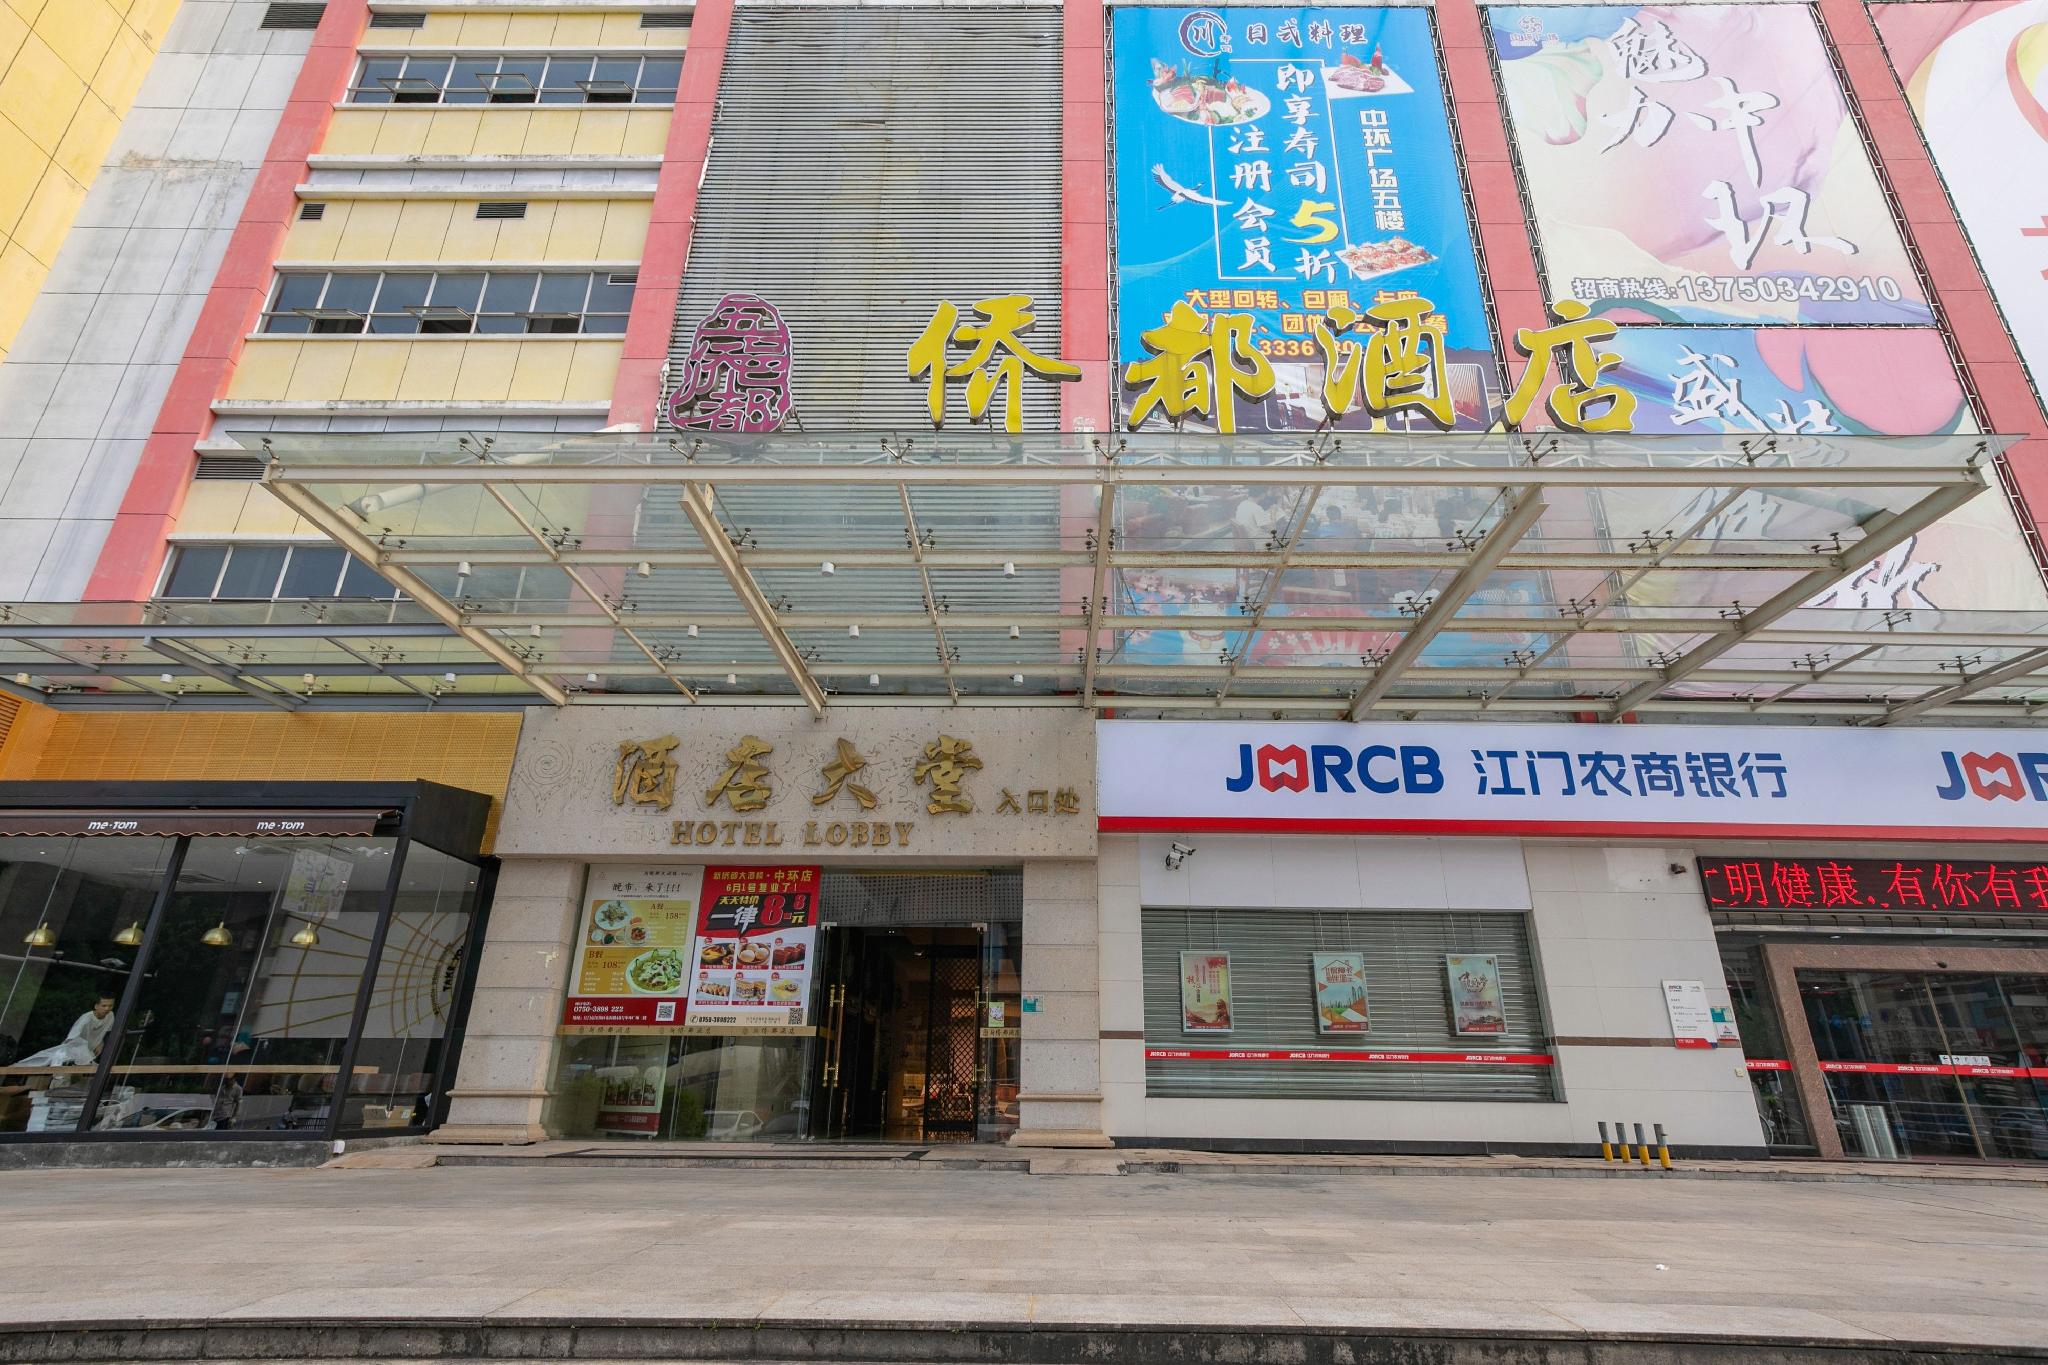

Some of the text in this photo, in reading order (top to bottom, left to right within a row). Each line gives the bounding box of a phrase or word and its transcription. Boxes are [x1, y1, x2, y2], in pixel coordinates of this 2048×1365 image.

[1247, 18, 1368, 49] 日式料理
[1359, 109, 1405, 231] 中环广场五楼
[613, 733, 985, 816] 酒店大堂
[1473, 749, 1788, 799] 江门农商银行
[996, 786, 1081, 815] 入口处
[670, 820, 915, 848] HOTEL LOBBY
